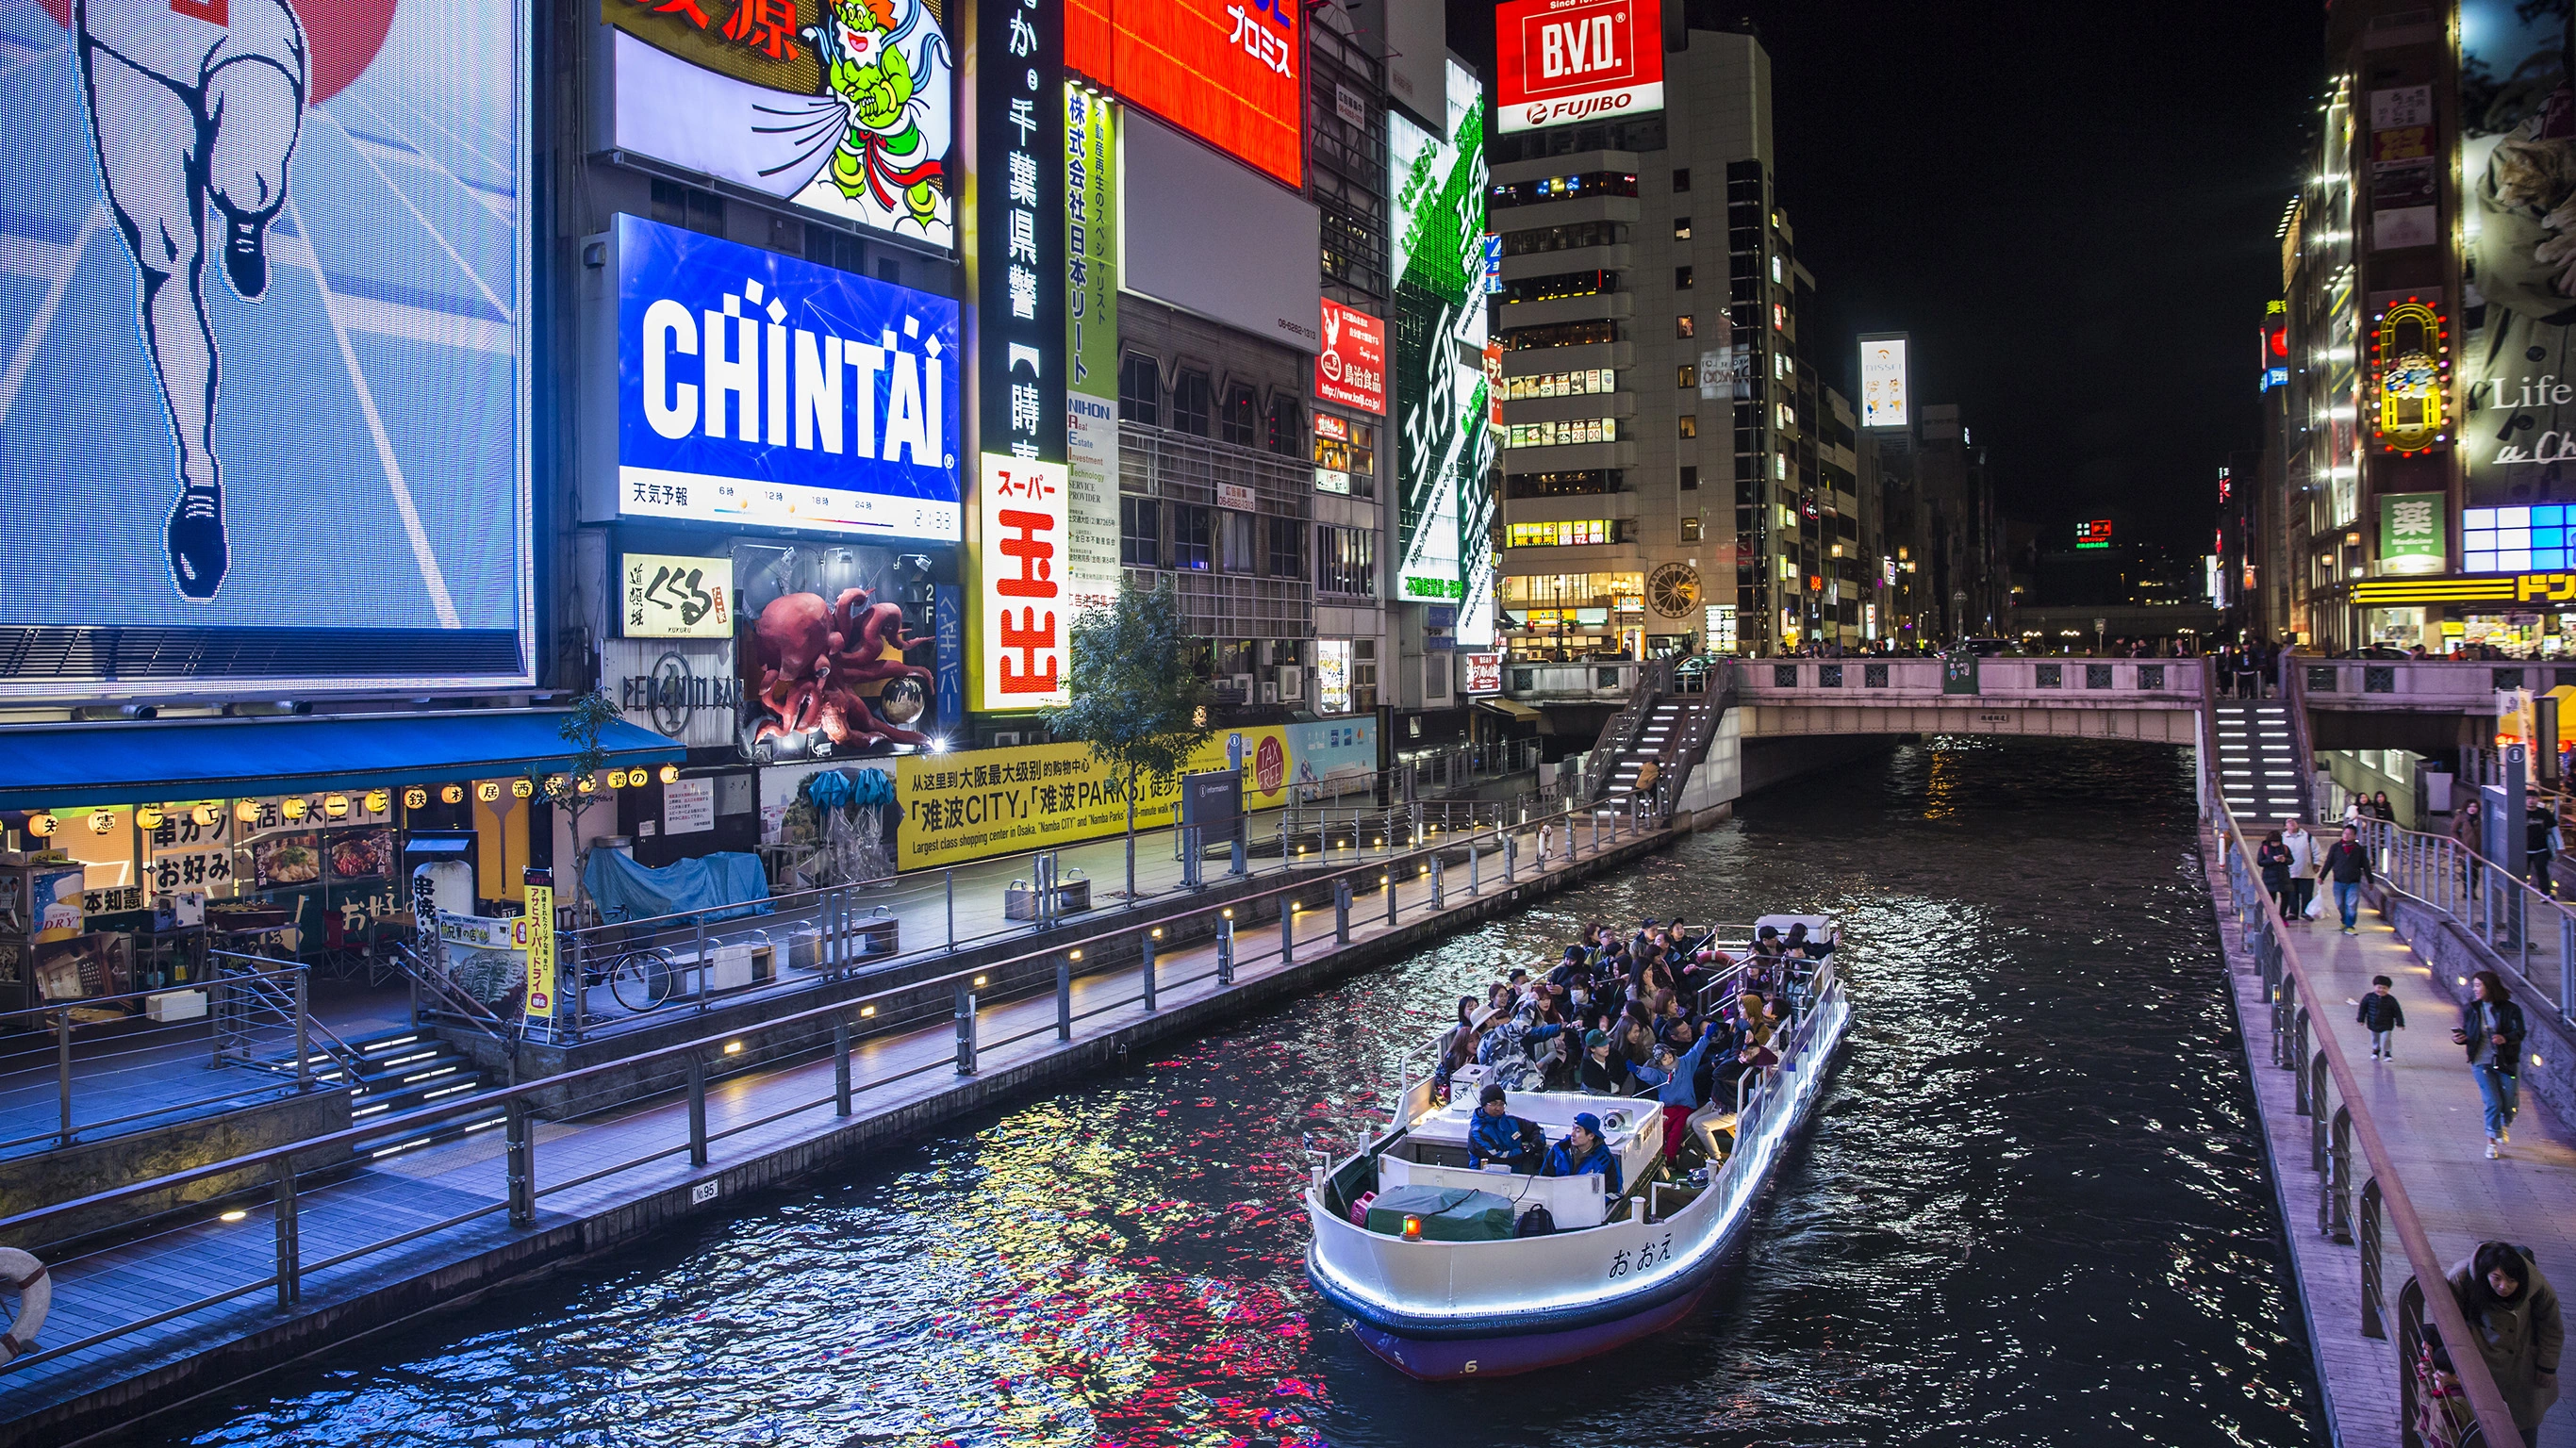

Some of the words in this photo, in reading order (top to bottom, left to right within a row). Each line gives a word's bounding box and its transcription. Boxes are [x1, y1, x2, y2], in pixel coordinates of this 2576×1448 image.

[1227, 4, 1292, 78] プロミス
[1542, 15, 1623, 78] B.V.D.
[1552, 93, 1631, 120] FUJIBO
[1068, 95, 1088, 386] 株式会社日本リート
[643, 277, 943, 469] CHINTAI
[2488, 374, 2574, 410] Life
[1067, 398, 1111, 420] NIHON
[1067, 415, 1088, 432] Real
[1068, 431, 1094, 449] Estate
[1067, 446, 1104, 467] Investment
[998, 470, 1055, 501] スーパー
[1067, 462, 1105, 483] Technology
[633, 482, 689, 506] 天気予報
[1068, 491, 1101, 503] PROVIDER
[2391, 501, 2433, 536] 薬
[2391, 537, 2434, 547] Medicine
[644, 566, 713, 626] くくる
[996, 509, 1058, 694] 玉出
[1260, 741, 1279, 767] TAX
[1258, 762, 1283, 789] FREE!
[912, 839, 939, 855] Largest
[940, 833, 958, 849] class
[959, 831, 988, 848] shopping
[989, 829, 1009, 842] center
[1010, 827, 1016, 838] in
[1017, 824, 1037, 837] Osaka,
[1077, 814, 1087, 827] and
[1157, 803, 1169, 814] walk
[157, 853, 231, 888] お好み
[84, 887, 141, 914] 本知憲
[531, 887, 542, 992] アサヒスーパードライ
[1609, 1232, 1675, 1279] おおえ
